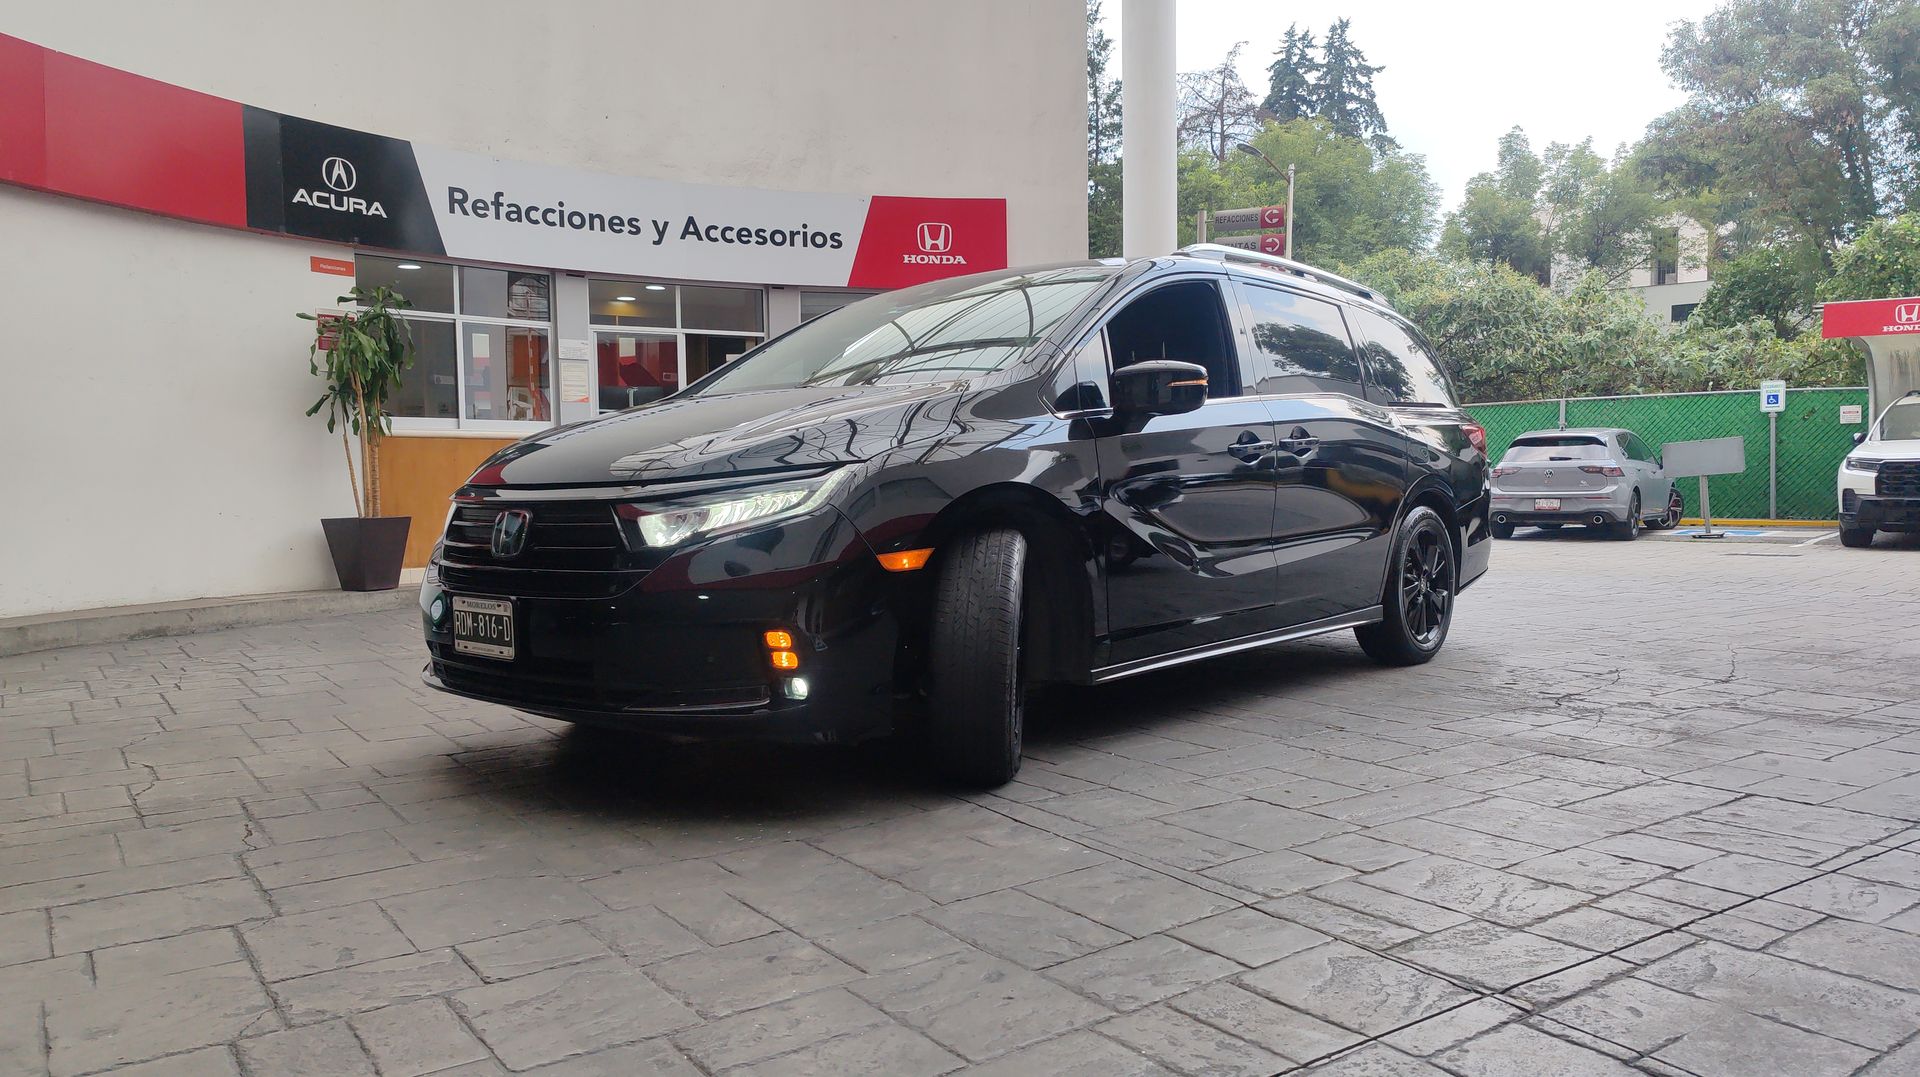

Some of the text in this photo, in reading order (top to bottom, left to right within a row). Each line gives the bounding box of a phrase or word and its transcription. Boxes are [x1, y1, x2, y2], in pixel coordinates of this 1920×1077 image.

[292, 188, 388, 219] ACURA
[448, 186, 843, 250] Refacciones y Accesorios
[1215, 213, 1259, 224] REFACCIONES
[902, 254, 967, 265] HONDA
[1882, 324, 1920, 332] HOND
[455, 611, 511, 641] RDM-816-D
